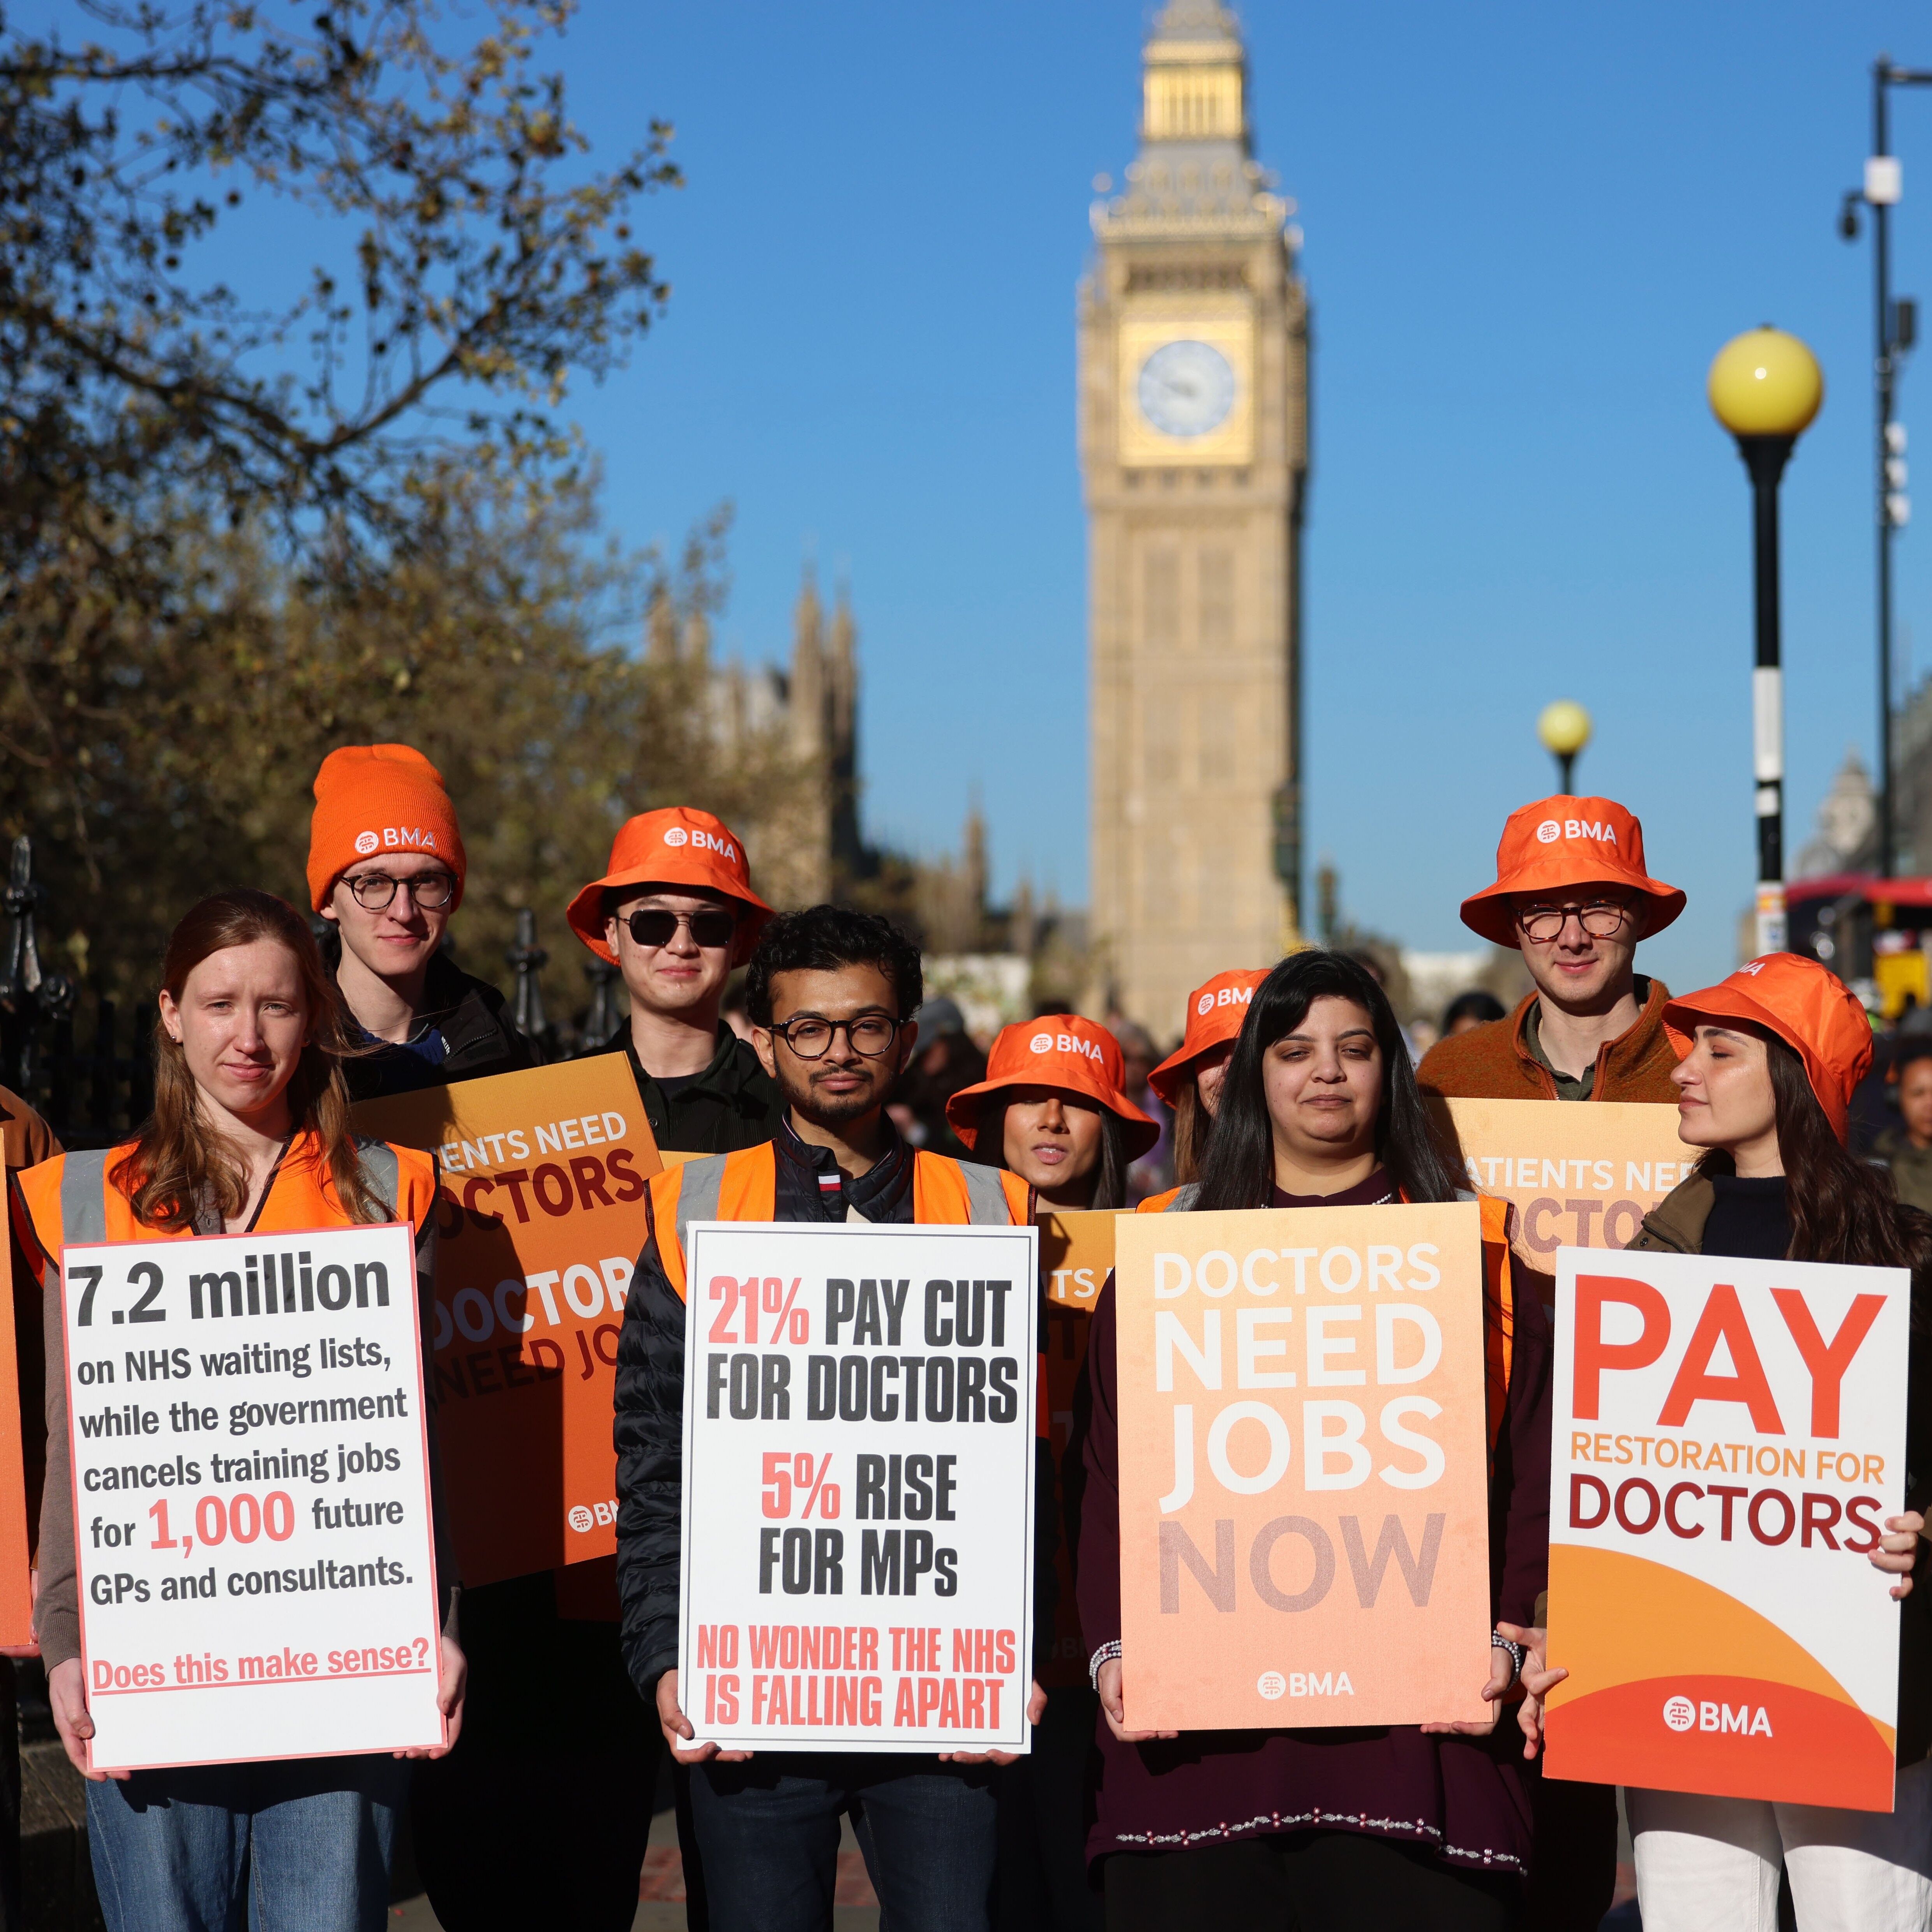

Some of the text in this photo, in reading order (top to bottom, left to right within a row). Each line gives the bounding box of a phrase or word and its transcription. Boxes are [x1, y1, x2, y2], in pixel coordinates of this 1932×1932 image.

[383, 827, 436, 851] BMA
[692, 830, 736, 864] BMA
[1565, 819, 1617, 845] BMA
[1217, 987, 1253, 1007] BM
[1737, 962, 1766, 976] MA
[1057, 1034, 1104, 1065] BMA
[429, 1112, 626, 1174] ENTS NEED
[438, 1149, 644, 1239] OCTORS
[1463, 1156, 1614, 1191] ATIENTS
[68, 1251, 390, 1326] 7.2 million
[1154, 1243, 1441, 1299] DOCTORS
[434, 1253, 640, 1351] OCTOR
[709, 1276, 809, 1345] 21%
[825, 1279, 910, 1346] PAY
[923, 1280, 1012, 1348] CUT
[77, 1337, 391, 1385] on NHS waiting lists,
[575, 1324, 621, 1381] JO
[1154, 1303, 1442, 1392] NEED
[1572, 1274, 1888, 1439] PAY
[79, 1387, 408, 1438] while the government
[706, 1353, 1018, 1424] FOR DOCTORS
[84, 1442, 401, 1492] cancels training jobs
[1158, 1396, 1445, 1514] JOBS
[1570, 1431, 1886, 1485] RESTORATION FOR
[761, 1452, 957, 1522] 5% RISE
[1569, 1473, 1883, 1554] DOCTORS
[90, 1491, 404, 1559] for 1,000 future
[90, 1556, 413, 1605] GPs and consultants.
[759, 1528, 958, 1597] FOR MPs
[1159, 1512, 1446, 1614] NOW
[92, 1637, 429, 1690] Does this make sense?
[697, 1624, 739, 1670] NO
[749, 1625, 880, 1671] WONDER
[888, 1627, 941, 1673] THE
[952, 1629, 1016, 1674] NHS
[704, 1674, 1005, 1730] IS FALLING APART
[1290, 1671, 1354, 1697] BMA
[1700, 1701, 1773, 1738] BMA
